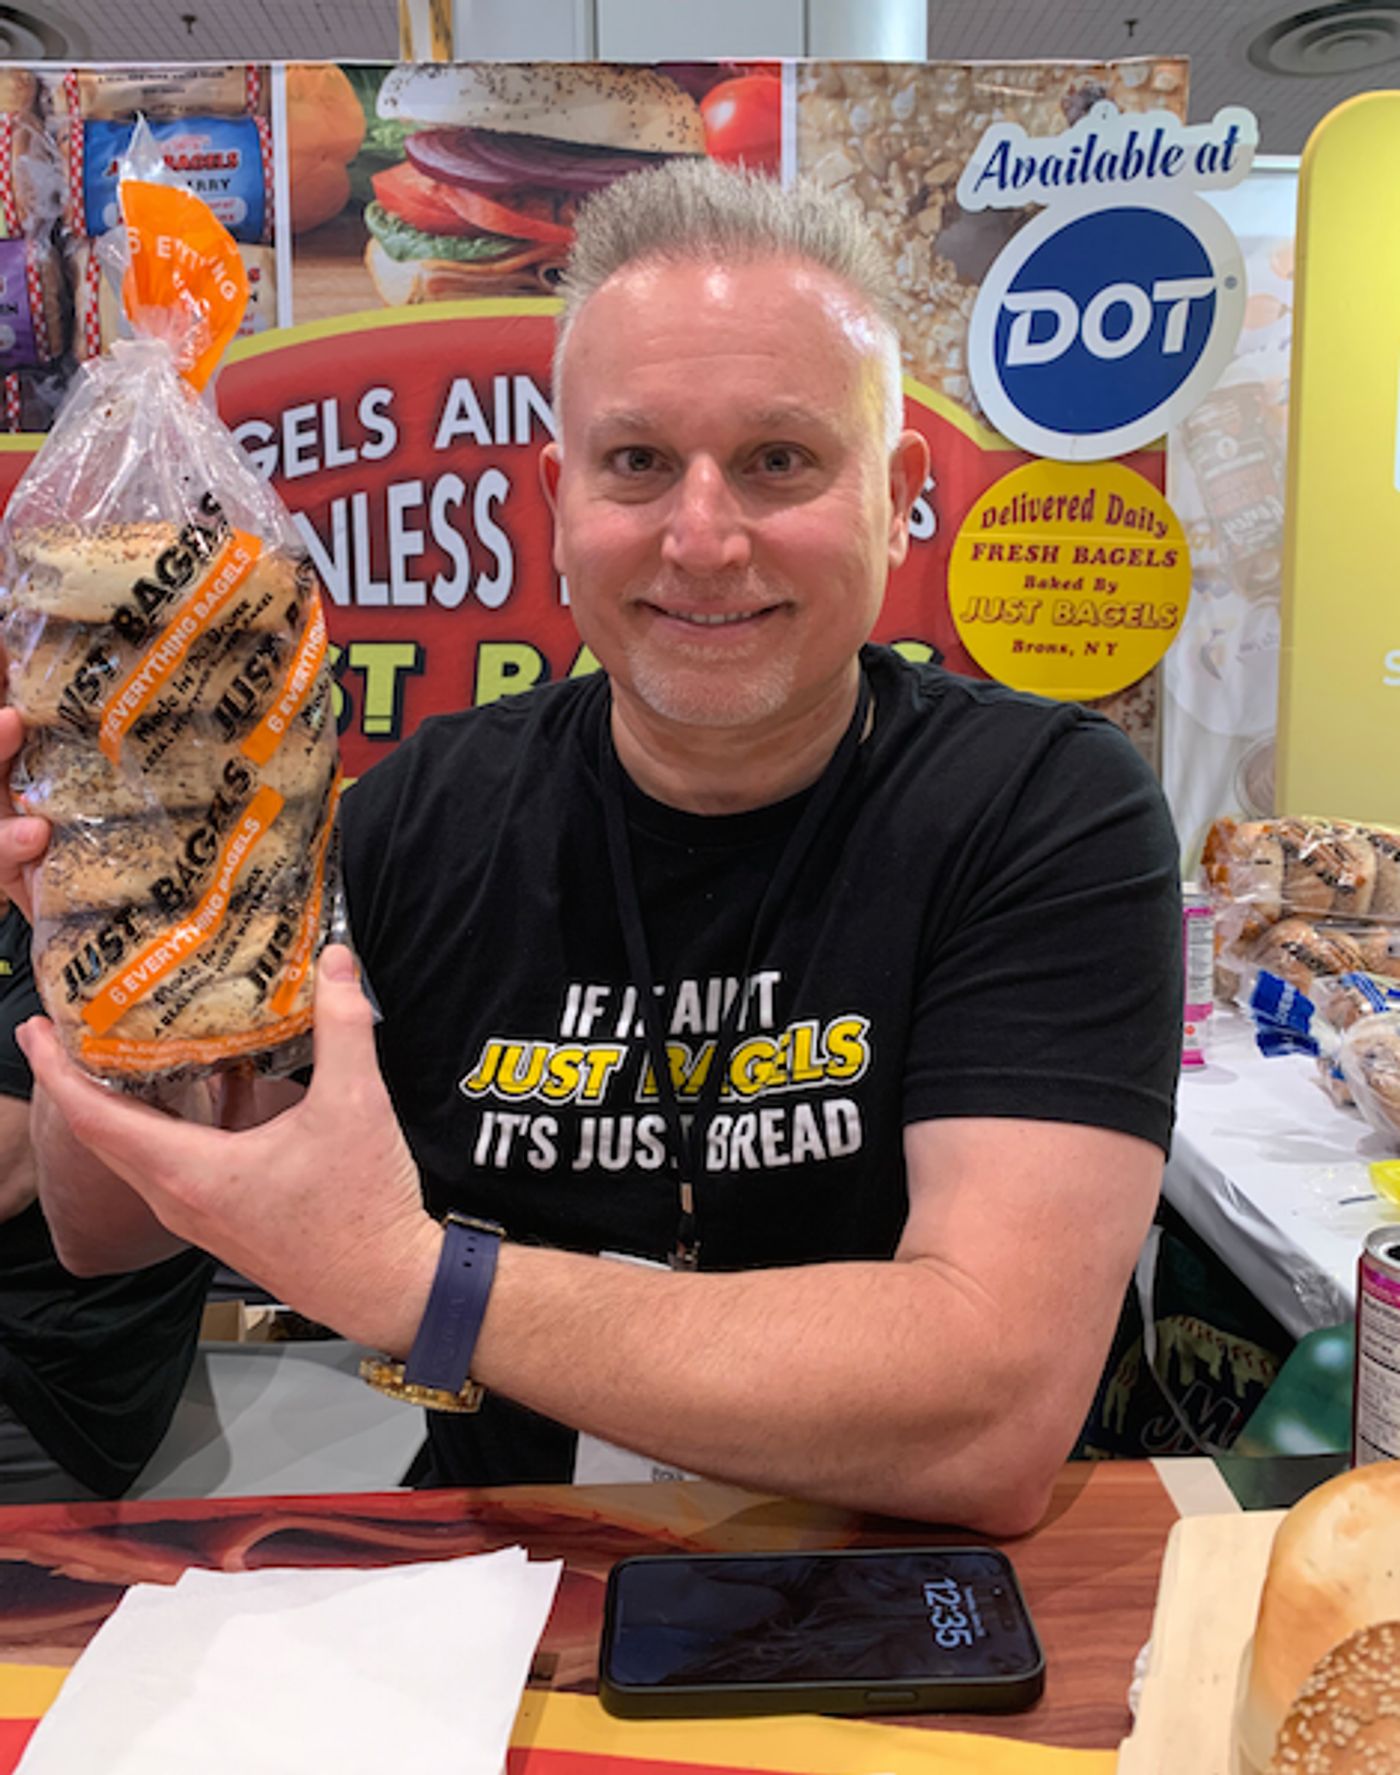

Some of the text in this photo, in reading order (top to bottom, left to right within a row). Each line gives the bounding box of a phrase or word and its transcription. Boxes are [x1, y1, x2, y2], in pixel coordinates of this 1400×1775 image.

[973, 124, 1241, 193] Available at
[1001, 276, 1216, 367] DOT
[434, 375, 566, 451] AIN
[980, 488, 1096, 530] Delivered
[1105, 493, 1169, 540] Daily
[192, 546, 252, 619] BAGELS
[970, 542, 1179, 568] FRESH BAGELS
[1023, 575, 1119, 595] Baked By
[960, 597, 1179, 630] JUST BAGELS
[1382, 649, 1400, 687] S
[108, 985, 128, 1006] 6
[121, 892, 225, 994] EVERYTHING
[217, 815, 261, 894] BAGELS
[61, 905, 143, 1004] JUST
[560, 984, 612, 1038] IF
[460, 1038, 629, 1105] JUST
[473, 1097, 863, 1172] IT'S JUS BREAD
[922, 1576, 973, 1649] 12:35
